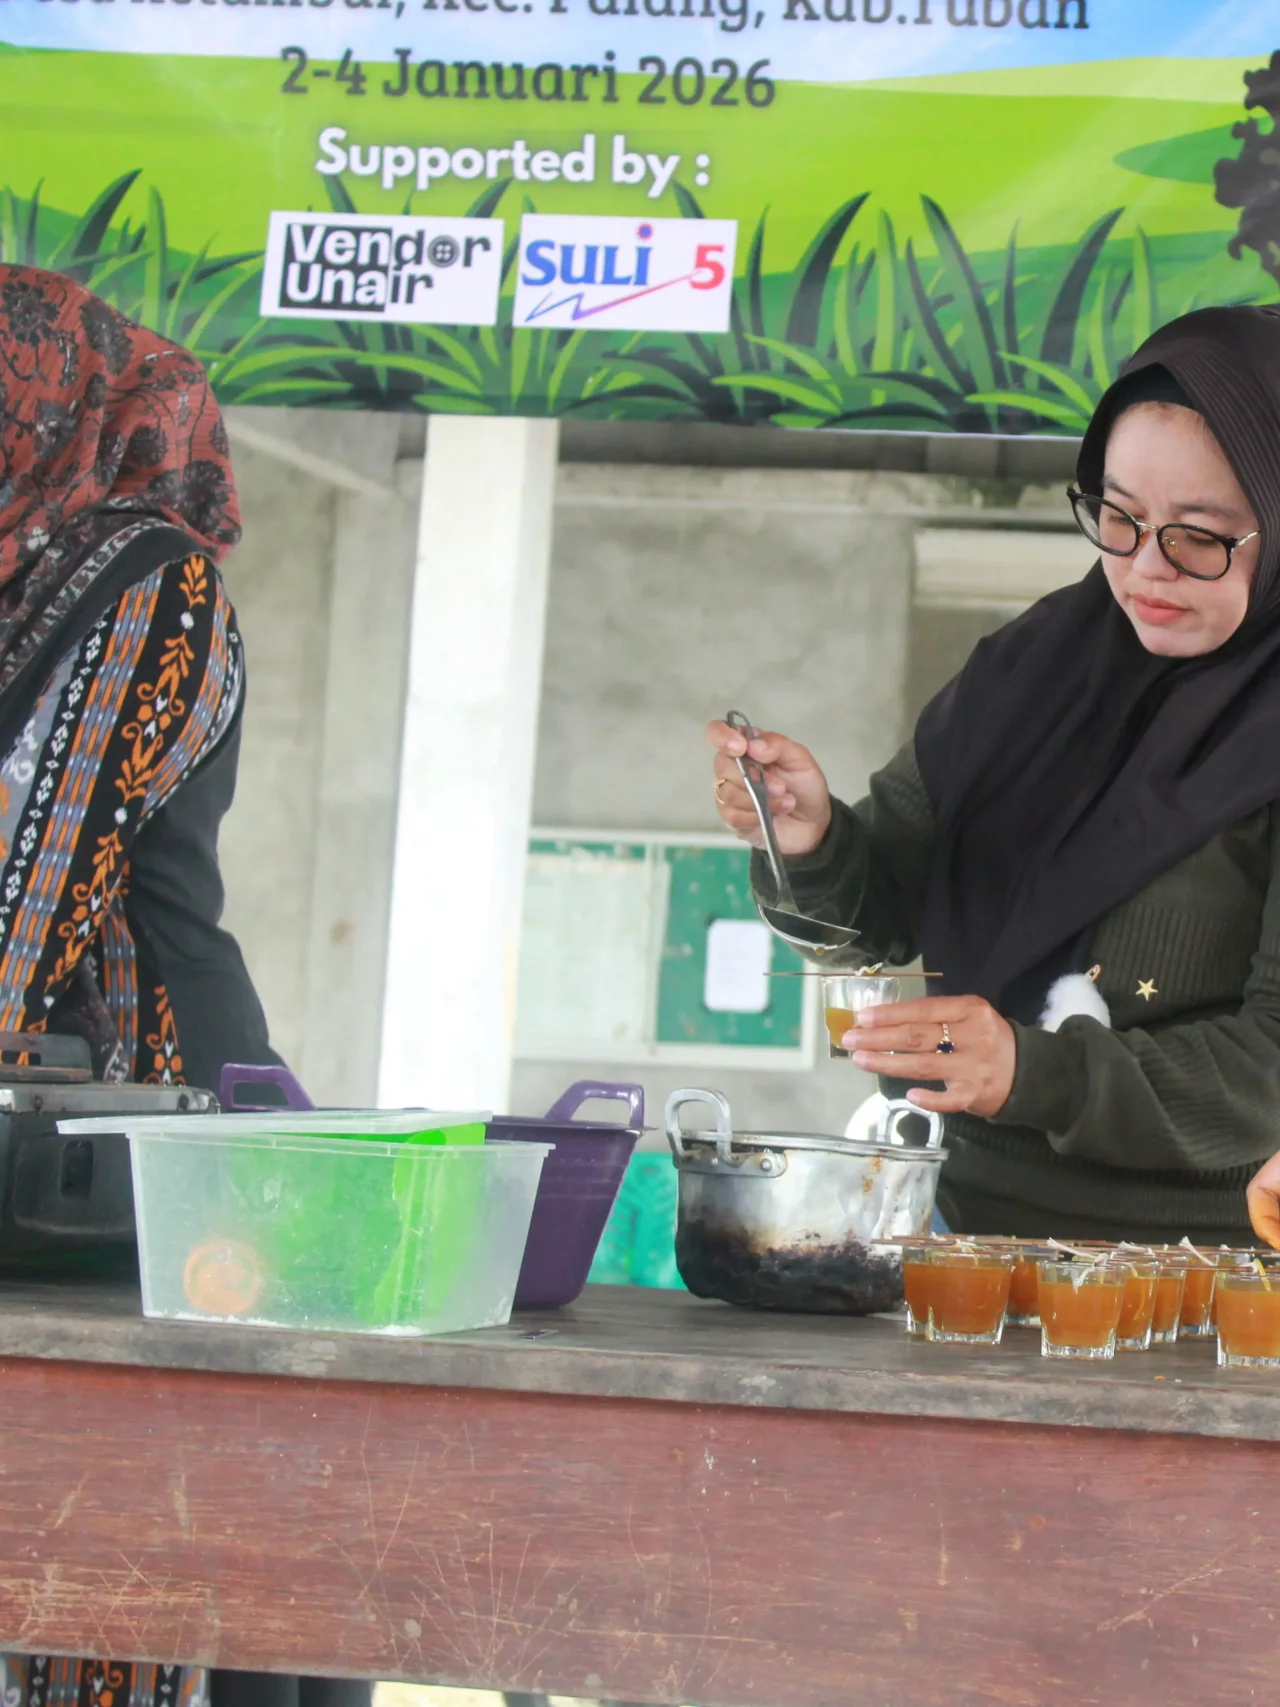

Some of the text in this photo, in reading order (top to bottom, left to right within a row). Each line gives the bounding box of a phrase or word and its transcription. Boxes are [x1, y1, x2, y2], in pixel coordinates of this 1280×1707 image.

[281, 46, 776, 107] 2-4 Januari 2026
[315, 126, 596, 190] Supported
[612, 134, 681, 198] by
[290, 223, 492, 269] Vendor
[689, 243, 725, 290] 5
[286, 262, 433, 305] Unair
